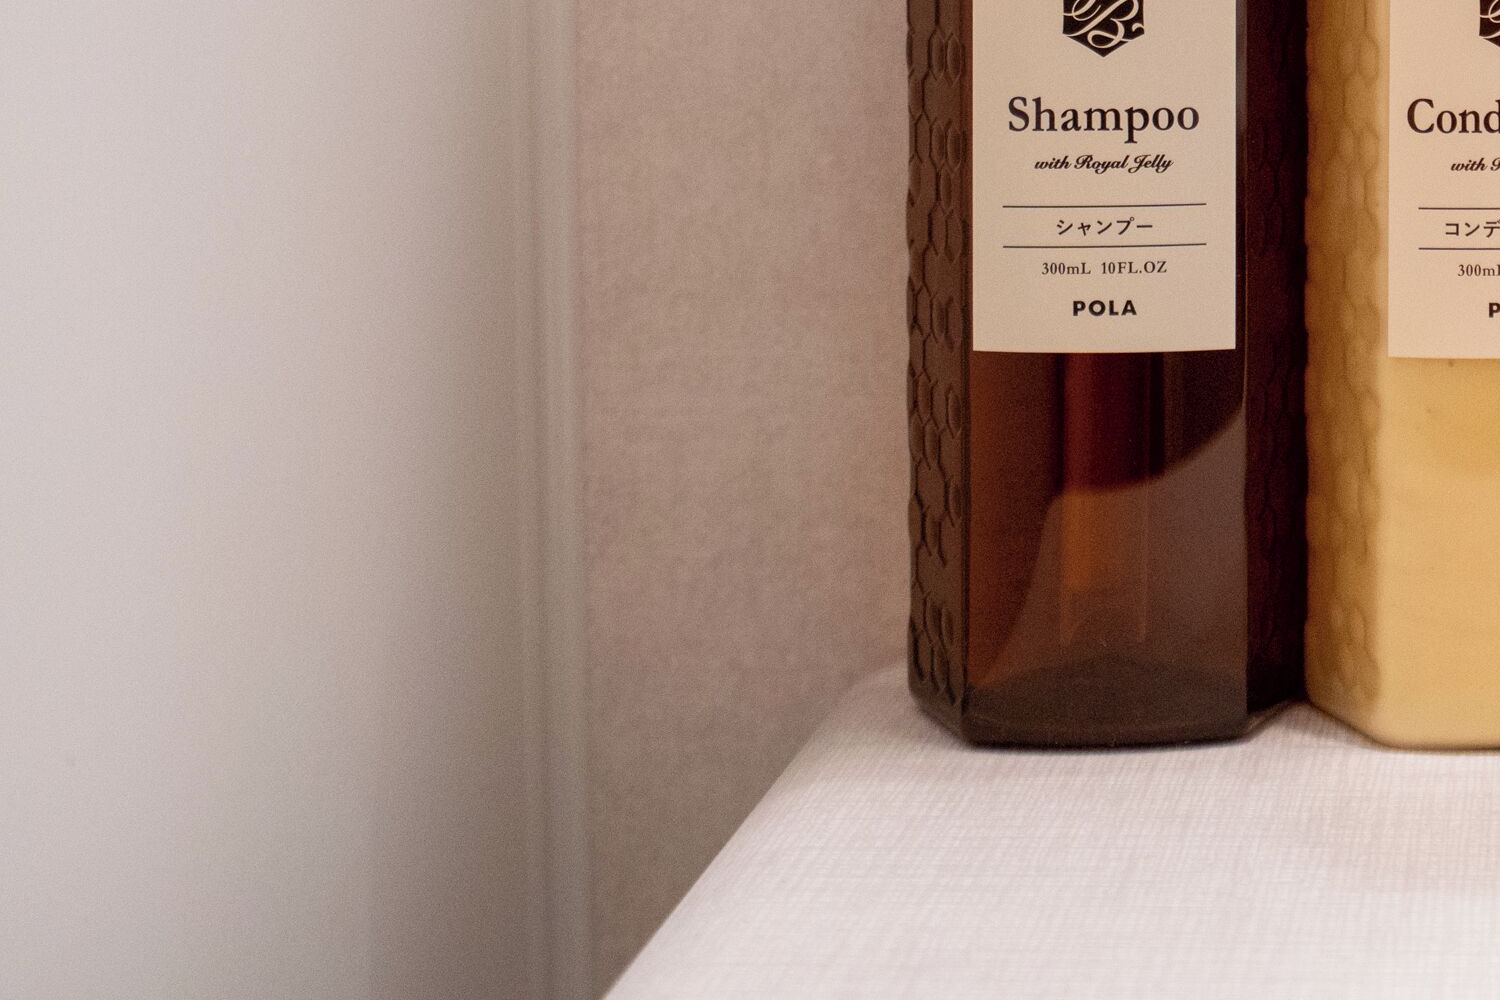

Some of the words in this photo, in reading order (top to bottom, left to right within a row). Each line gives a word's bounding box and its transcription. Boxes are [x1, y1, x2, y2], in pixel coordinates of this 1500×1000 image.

[1008, 96, 1200, 144] Shampoo
[1034, 155, 1072, 170] with
[1073, 154, 1130, 175] Royal
[1127, 153, 1174, 174] Jelly
[1450, 157, 1486, 172] with
[1056, 216, 1153, 237] シャンプー
[1041, 262, 1092, 275] 300mL
[1101, 260, 1167, 275] 10FL.OZ
[1072, 299, 1137, 317] POLA
